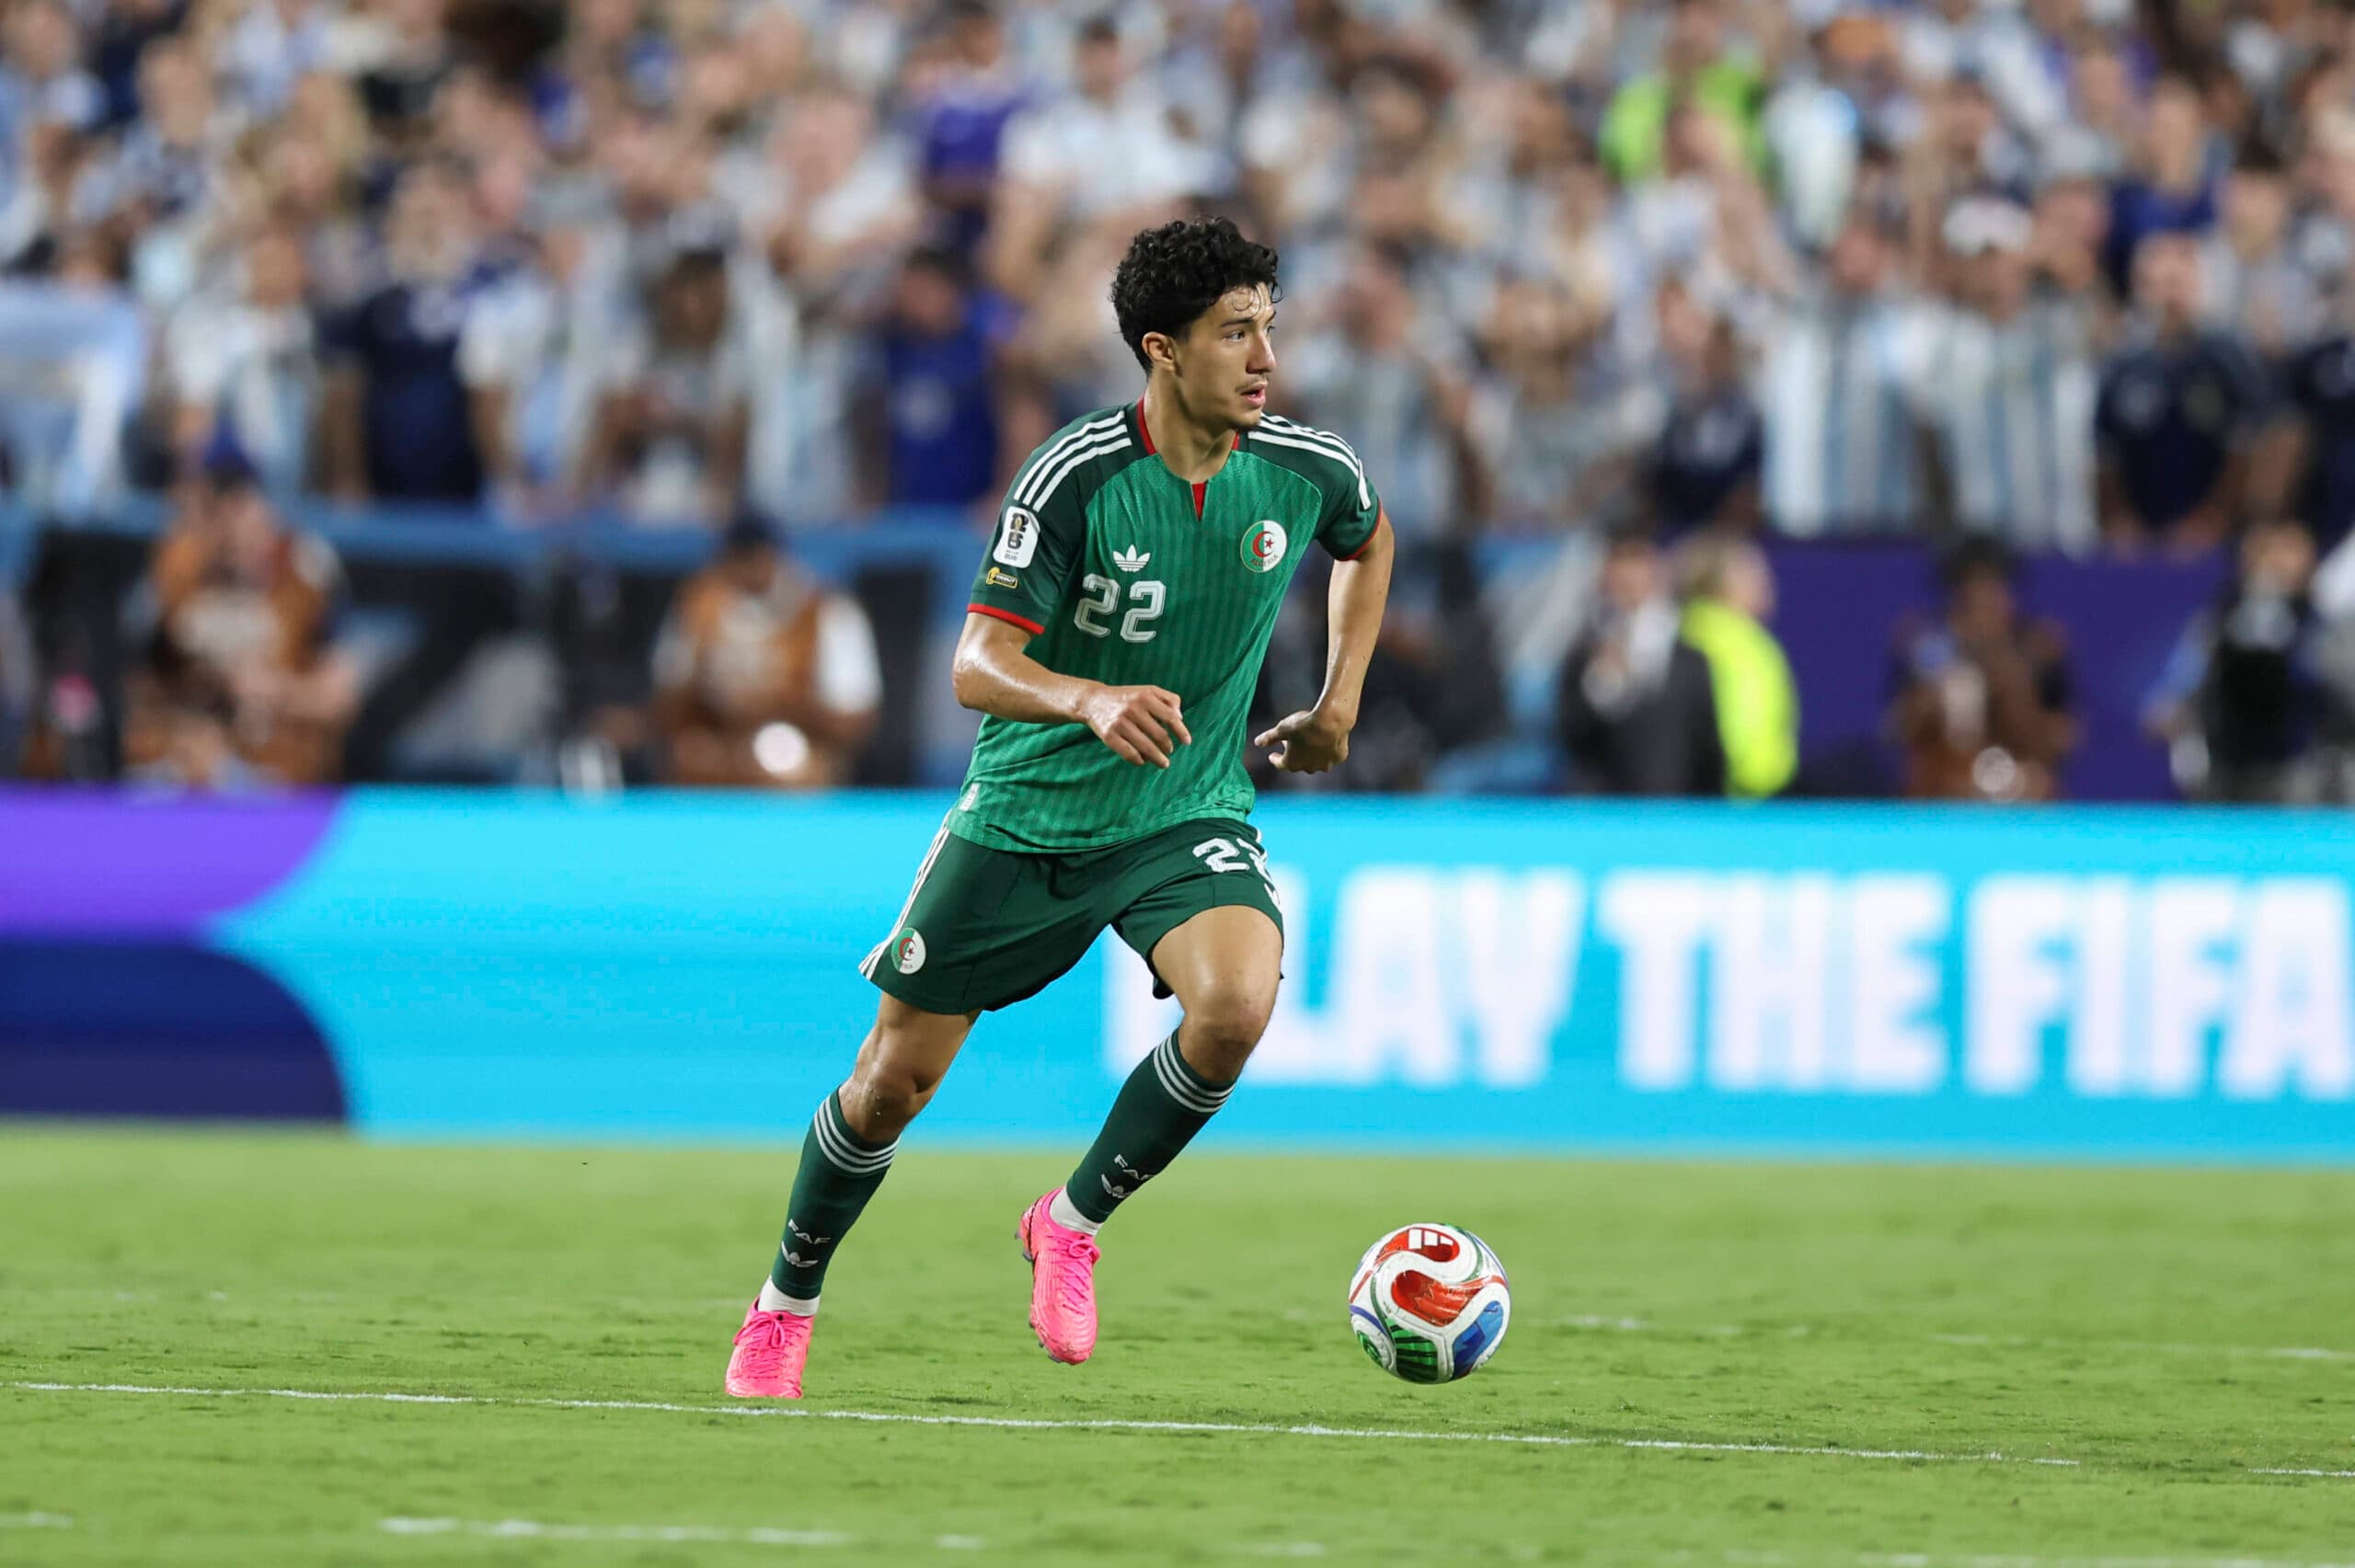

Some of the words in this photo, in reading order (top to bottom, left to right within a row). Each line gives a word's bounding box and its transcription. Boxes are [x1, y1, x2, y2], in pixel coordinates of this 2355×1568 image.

[1074, 573, 1166, 643] 22
[1599, 872, 1947, 1091] THE
[1969, 878, 2355, 1095] FIFA
[787, 1219, 831, 1244] FAF
